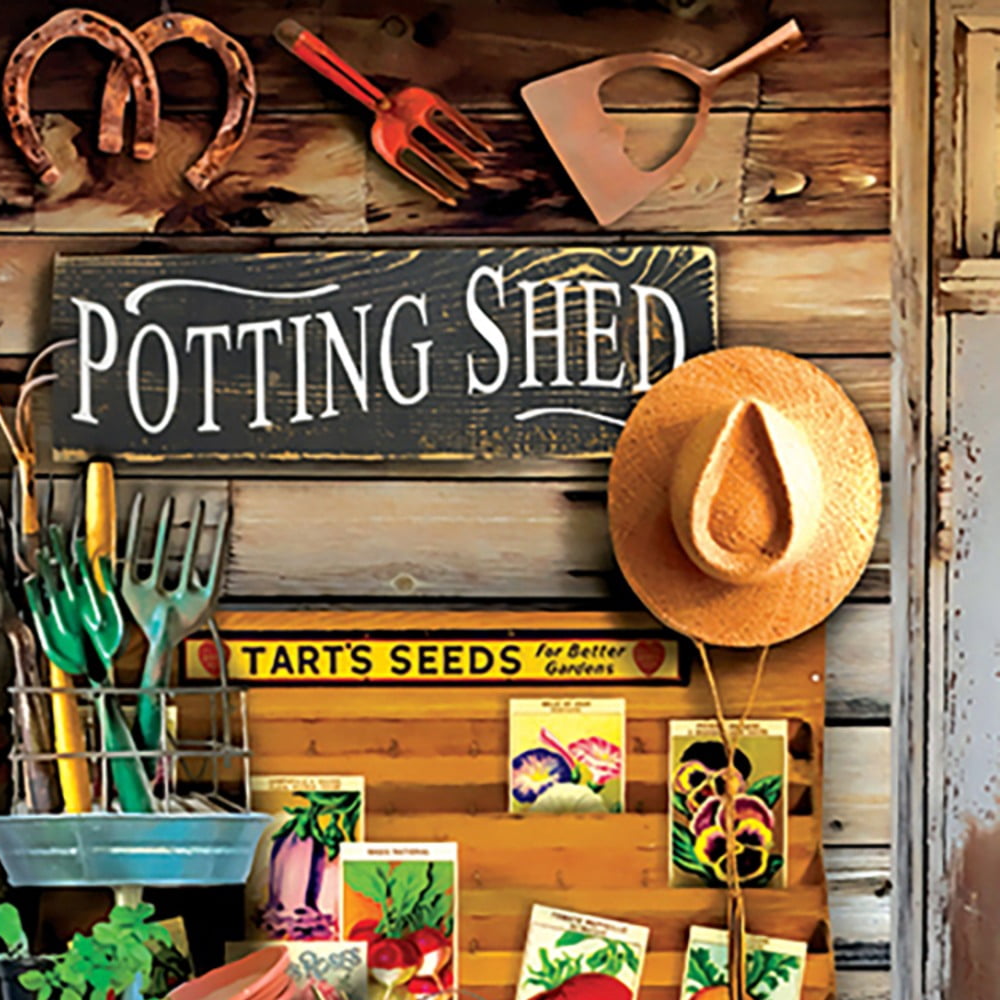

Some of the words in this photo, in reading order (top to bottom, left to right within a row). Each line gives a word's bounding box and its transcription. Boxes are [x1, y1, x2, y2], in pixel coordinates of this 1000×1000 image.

[70, 293, 435, 434] POTTING
[465, 264, 687, 396] SHED
[241, 641, 373, 676] TART'S
[389, 643, 524, 675] SEEDS
[534, 642, 563, 659] for
[566, 642, 627, 660] Better
[544, 659, 615, 677] Gardens
